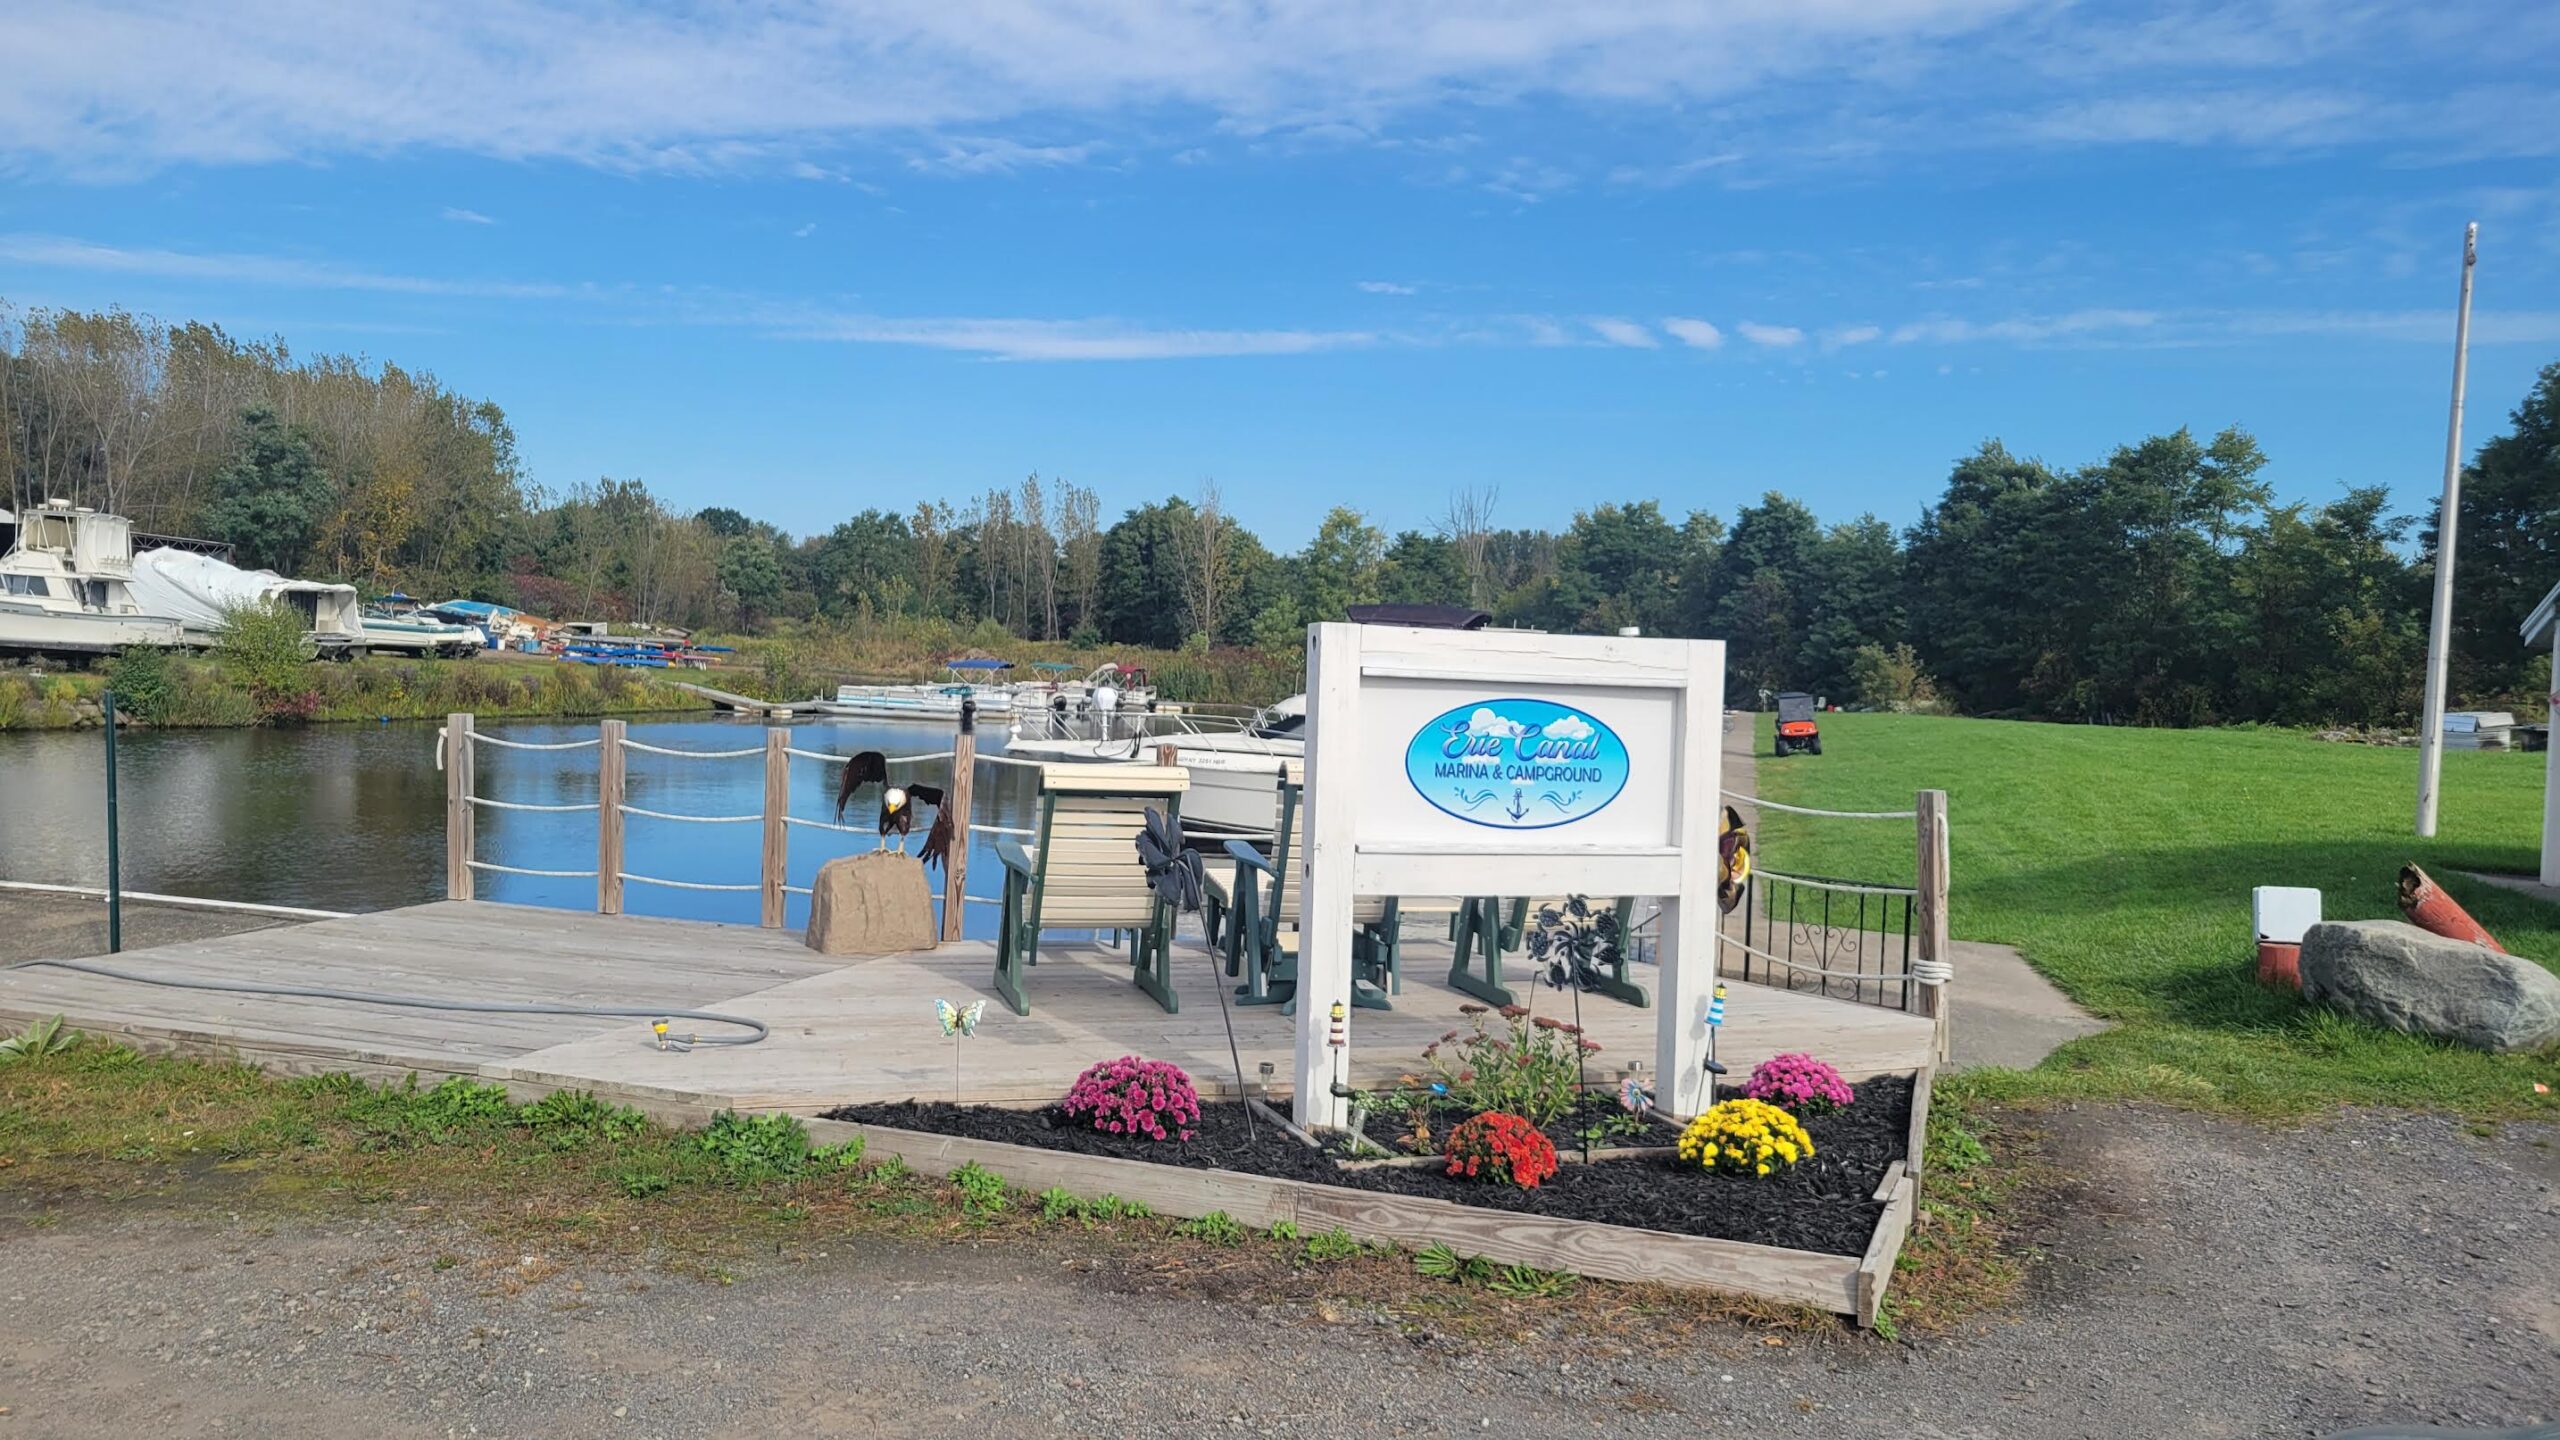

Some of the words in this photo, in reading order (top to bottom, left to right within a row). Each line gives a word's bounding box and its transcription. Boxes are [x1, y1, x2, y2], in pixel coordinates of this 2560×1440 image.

[1440, 720, 1503, 759] Erie
[1508, 723, 1602, 761] Canal
[1434, 762, 1489, 780] MARINA
[1492, 764, 1503, 780] &
[1506, 764, 1602, 783] CAMPGROUND
